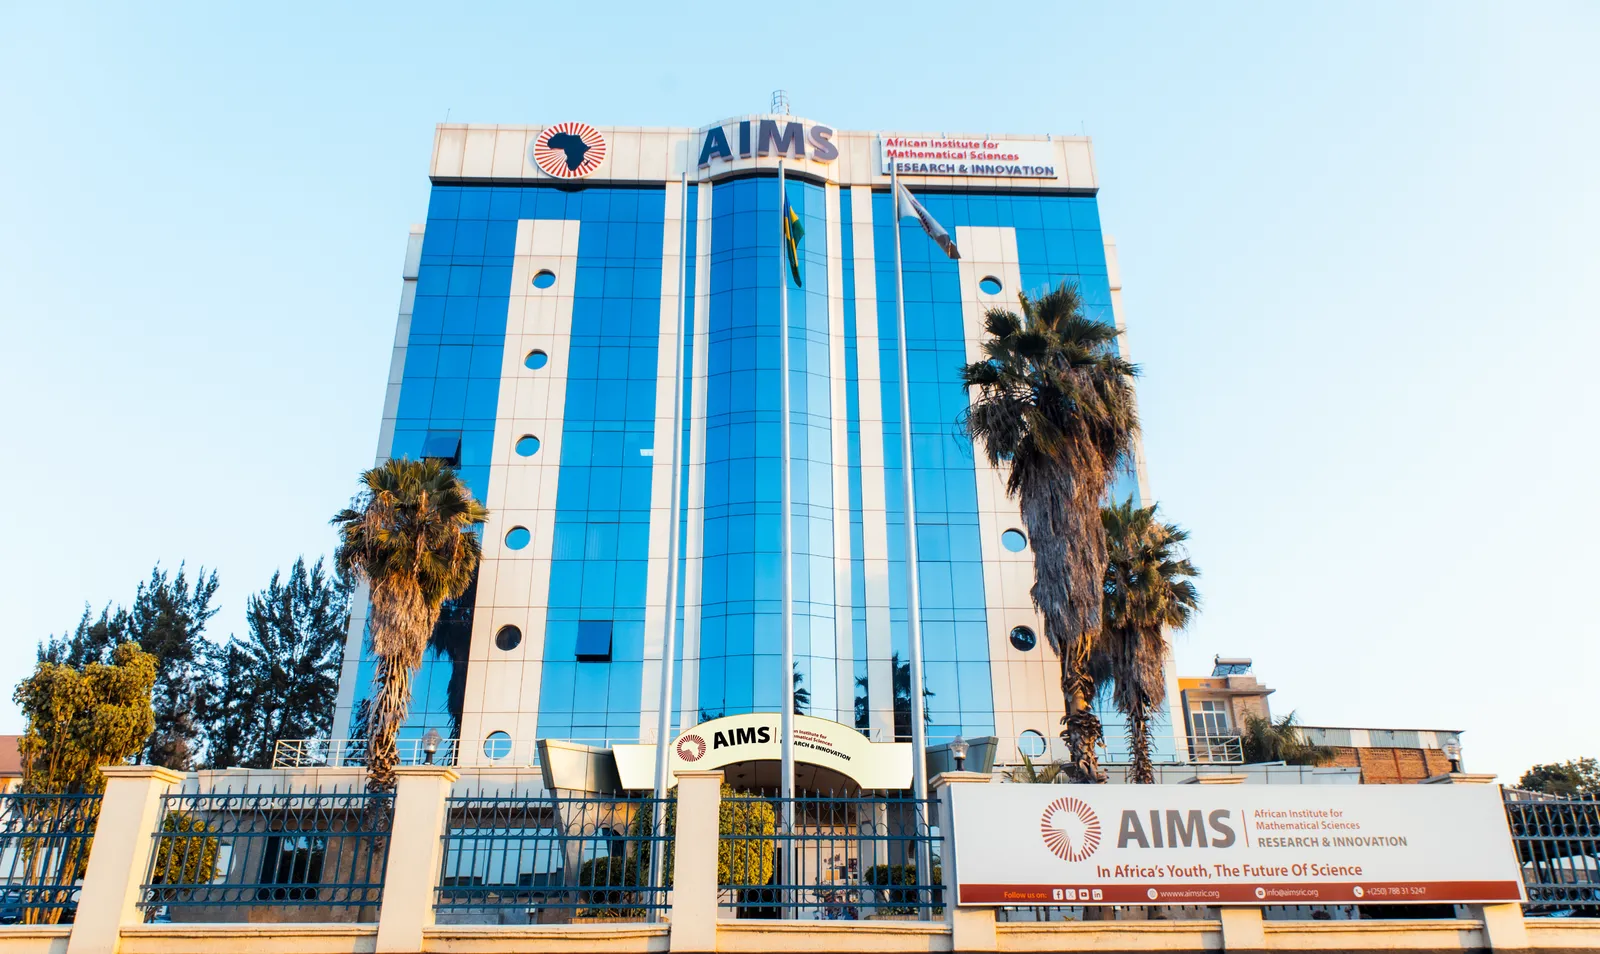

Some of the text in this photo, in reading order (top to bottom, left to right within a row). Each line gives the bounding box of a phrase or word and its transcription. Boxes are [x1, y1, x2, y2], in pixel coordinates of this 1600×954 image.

[698, 119, 839, 169] AIMS
[886, 138, 999, 149] African Institute for
[887, 149, 1019, 160] Mathematical Sciences
[959, 164, 968, 173] &
[972, 164, 1054, 175] INNOVATION
[713, 726, 770, 750] AIMS
[815, 745, 851, 761] INNOVATION
[1254, 809, 1343, 818] African Institute for
[1117, 809, 1236, 849] AIMS
[1256, 821, 1360, 830] Mathematical Sciences
[1258, 836, 1408, 848] RESEARCH & INNOVATION
[1097, 865, 1111, 878] In
[1168, 864, 1212, 879] Youth,
[1214, 864, 1240, 877] The
[1243, 864, 1289, 877] Future
[1291, 864, 1309, 877] Of
[1312, 863, 1363, 876] Science
[1003, 891, 1026, 899] Follow
[1388, 887, 1400, 895] 788
[1401, 886, 1409, 895] 31
[1410, 886, 1426, 895] 5247
